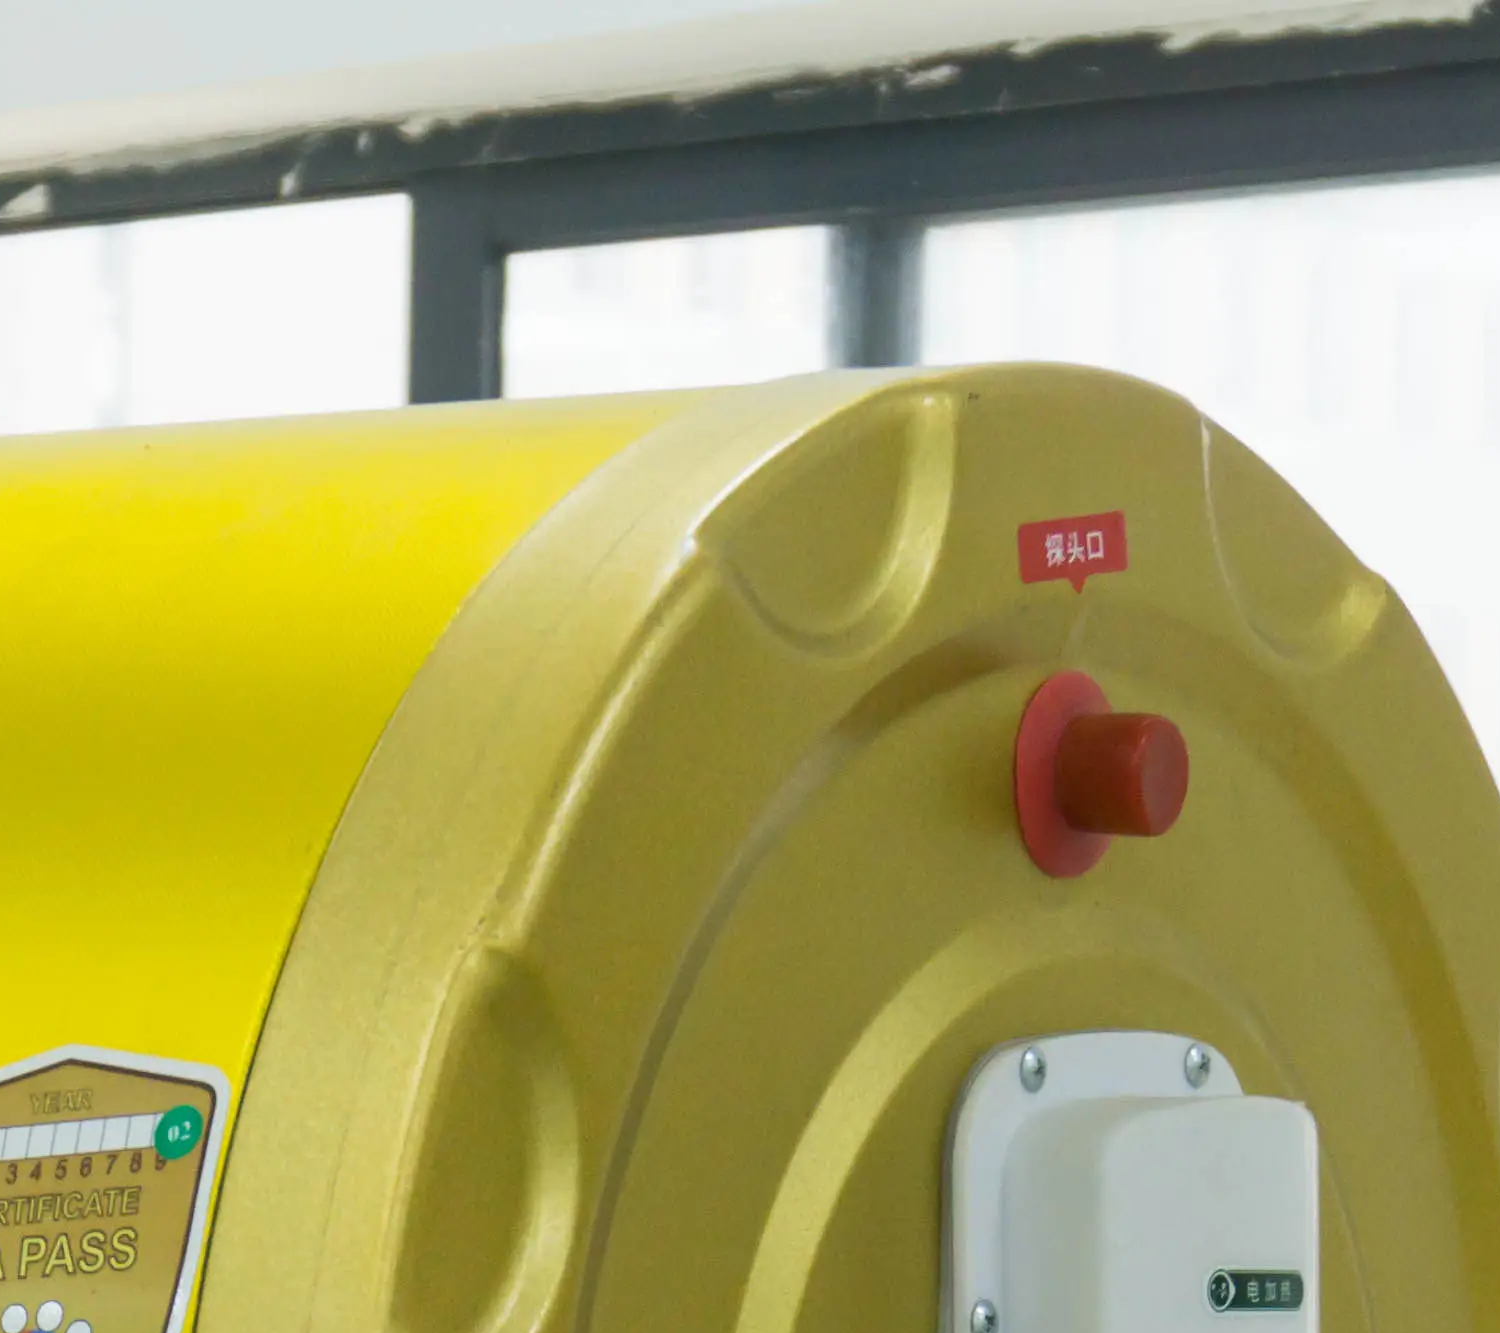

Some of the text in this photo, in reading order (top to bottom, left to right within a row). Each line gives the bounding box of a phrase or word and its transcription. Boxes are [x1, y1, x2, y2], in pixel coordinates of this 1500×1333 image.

[1045, 530, 1104, 567] 探头口
[29, 1088, 94, 1115] YEAR
[168, 1120, 191, 1143] 02
[5, 1163, 18, 1185] 3
[29, 1161, 42, 1182] 4
[55, 1159, 68, 1180] 5
[80, 1156, 92, 1178] 6
[104, 1154, 117, 1175] 7
[129, 1151, 142, 1173] 8
[17, 1227, 138, 1280] PASS
